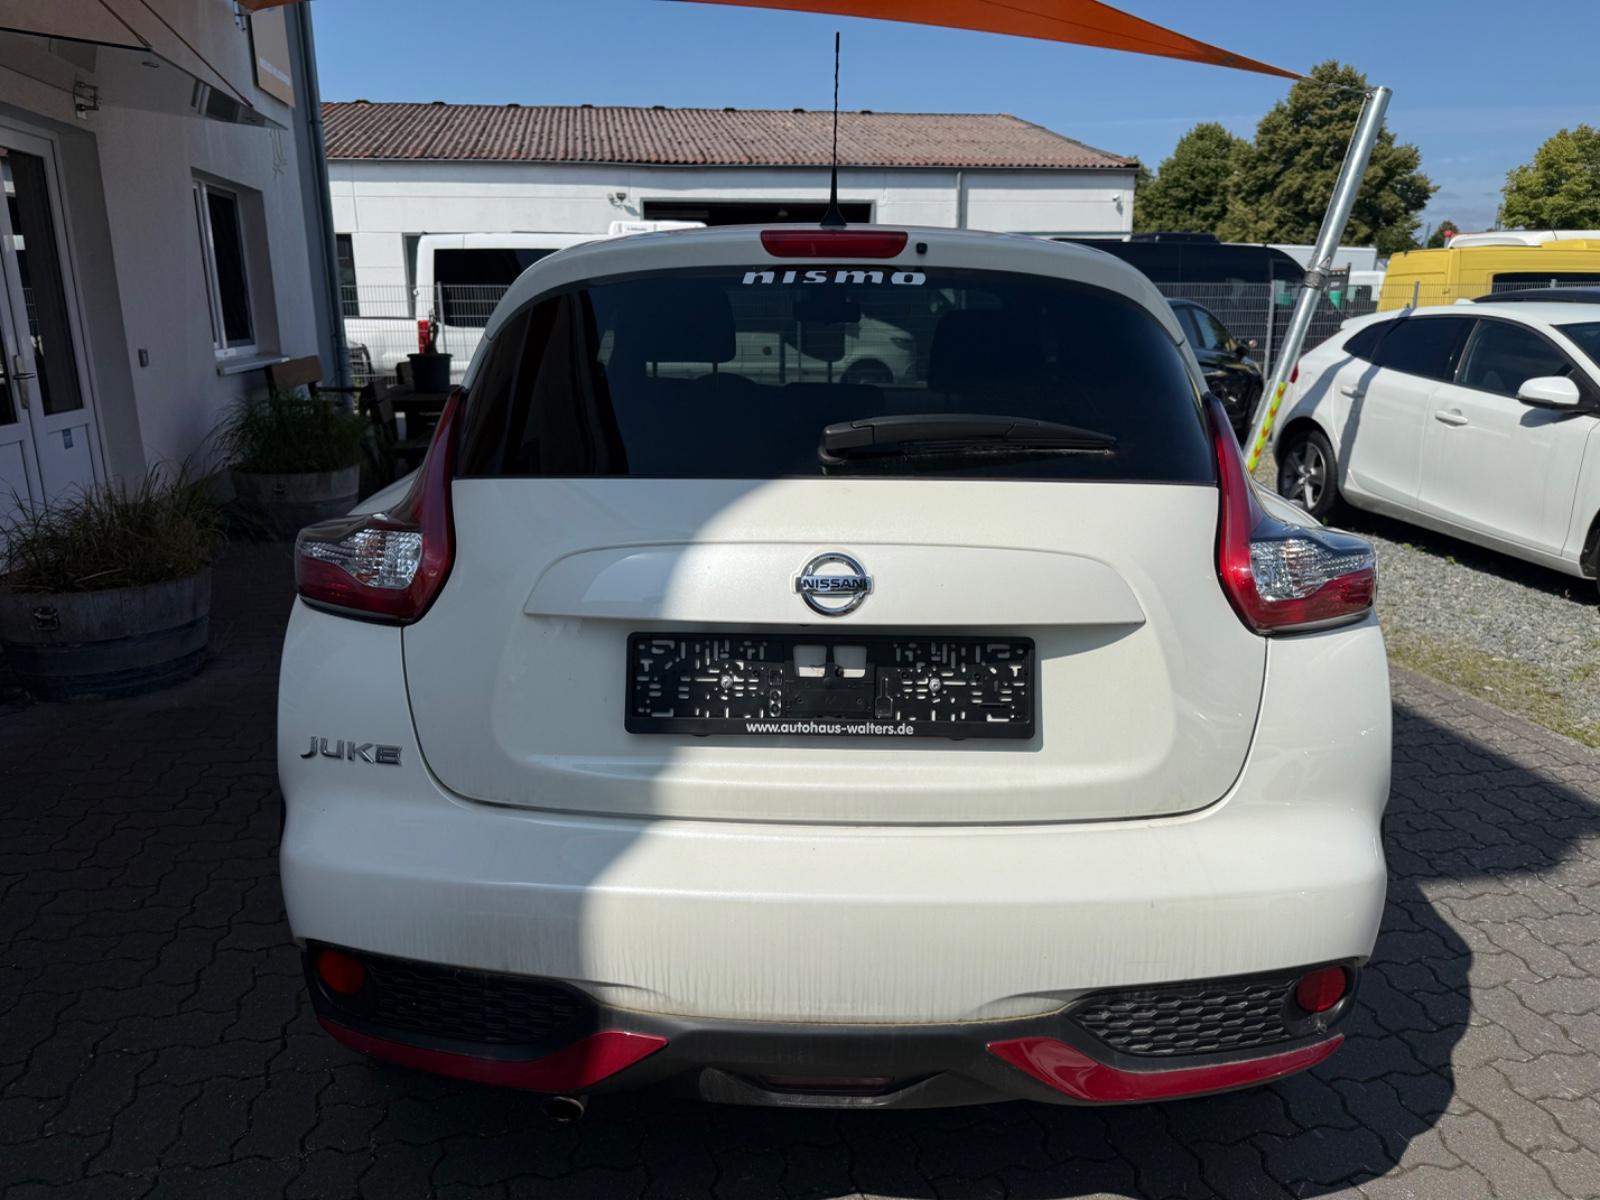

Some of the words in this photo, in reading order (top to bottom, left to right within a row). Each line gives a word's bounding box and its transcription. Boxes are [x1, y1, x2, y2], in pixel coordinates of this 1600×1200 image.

[742, 270, 926, 286] nismo
[802, 578, 867, 589] NISSAN
[746, 722, 914, 735] www.autohaus-walters.de
[300, 736, 402, 766] JUKE
